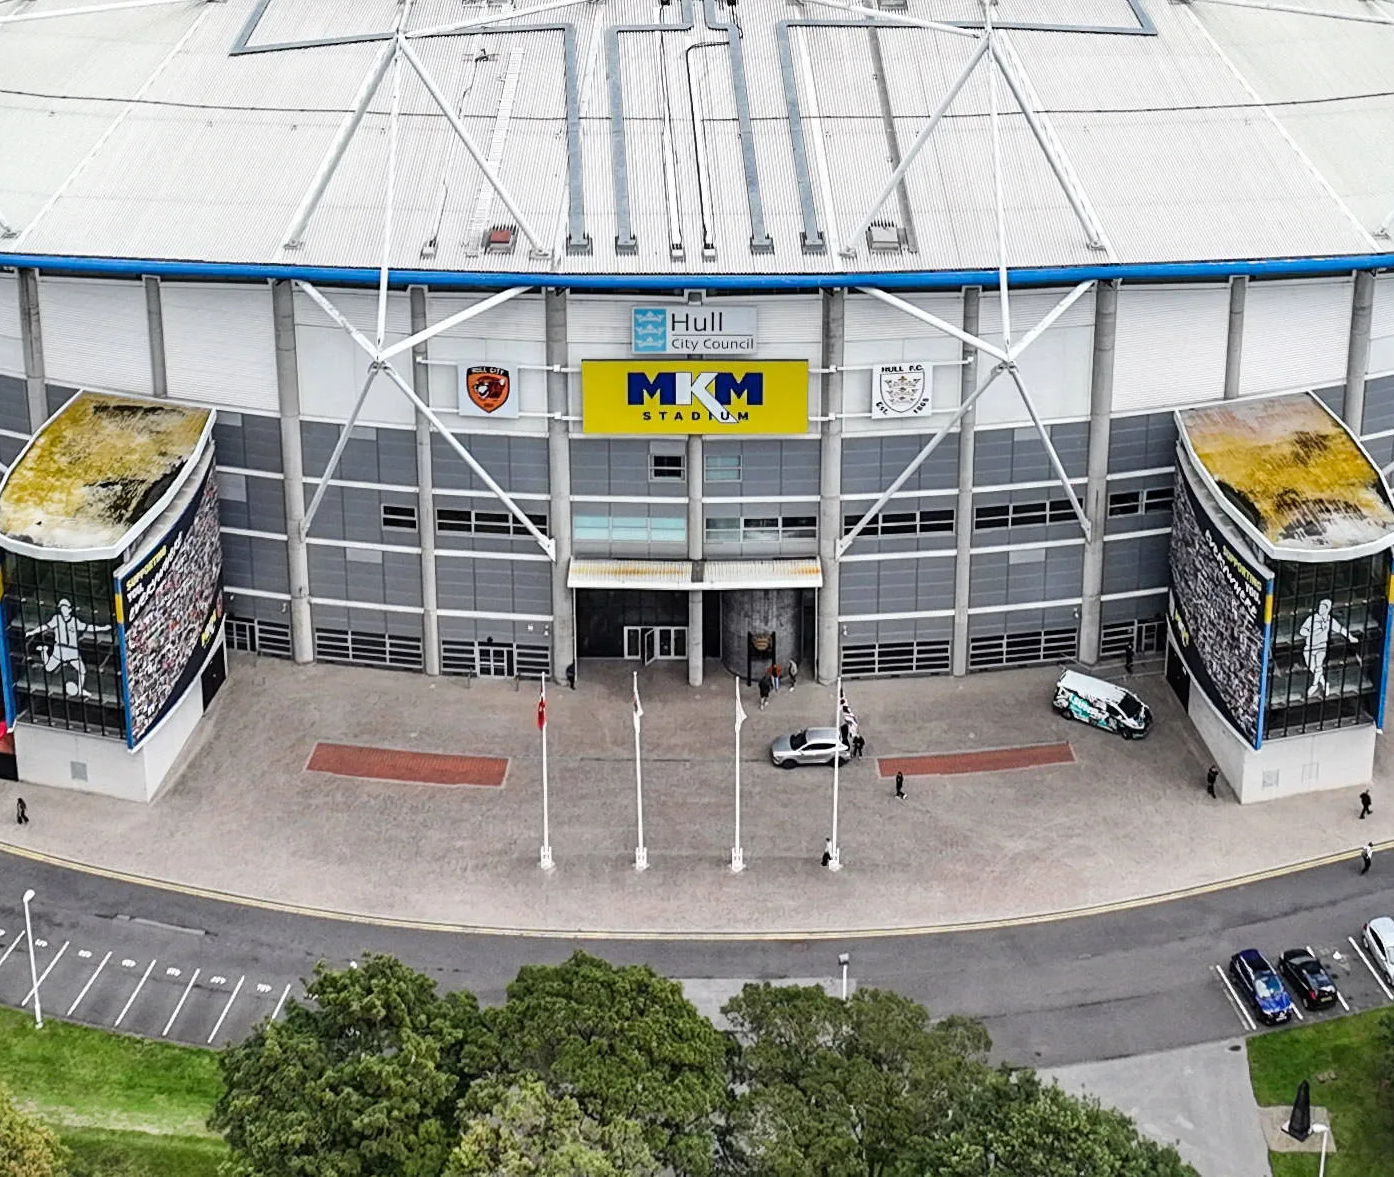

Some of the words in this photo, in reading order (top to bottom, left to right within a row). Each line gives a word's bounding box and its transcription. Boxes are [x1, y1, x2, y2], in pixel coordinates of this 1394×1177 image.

[671, 311, 723, 331] Hull
[671, 339, 699, 351] City
[703, 338, 754, 350] Council
[627, 372, 763, 423] MKM
[642, 411, 749, 421] STADIUM
[1223, 545, 1262, 592] SUPPORTING
